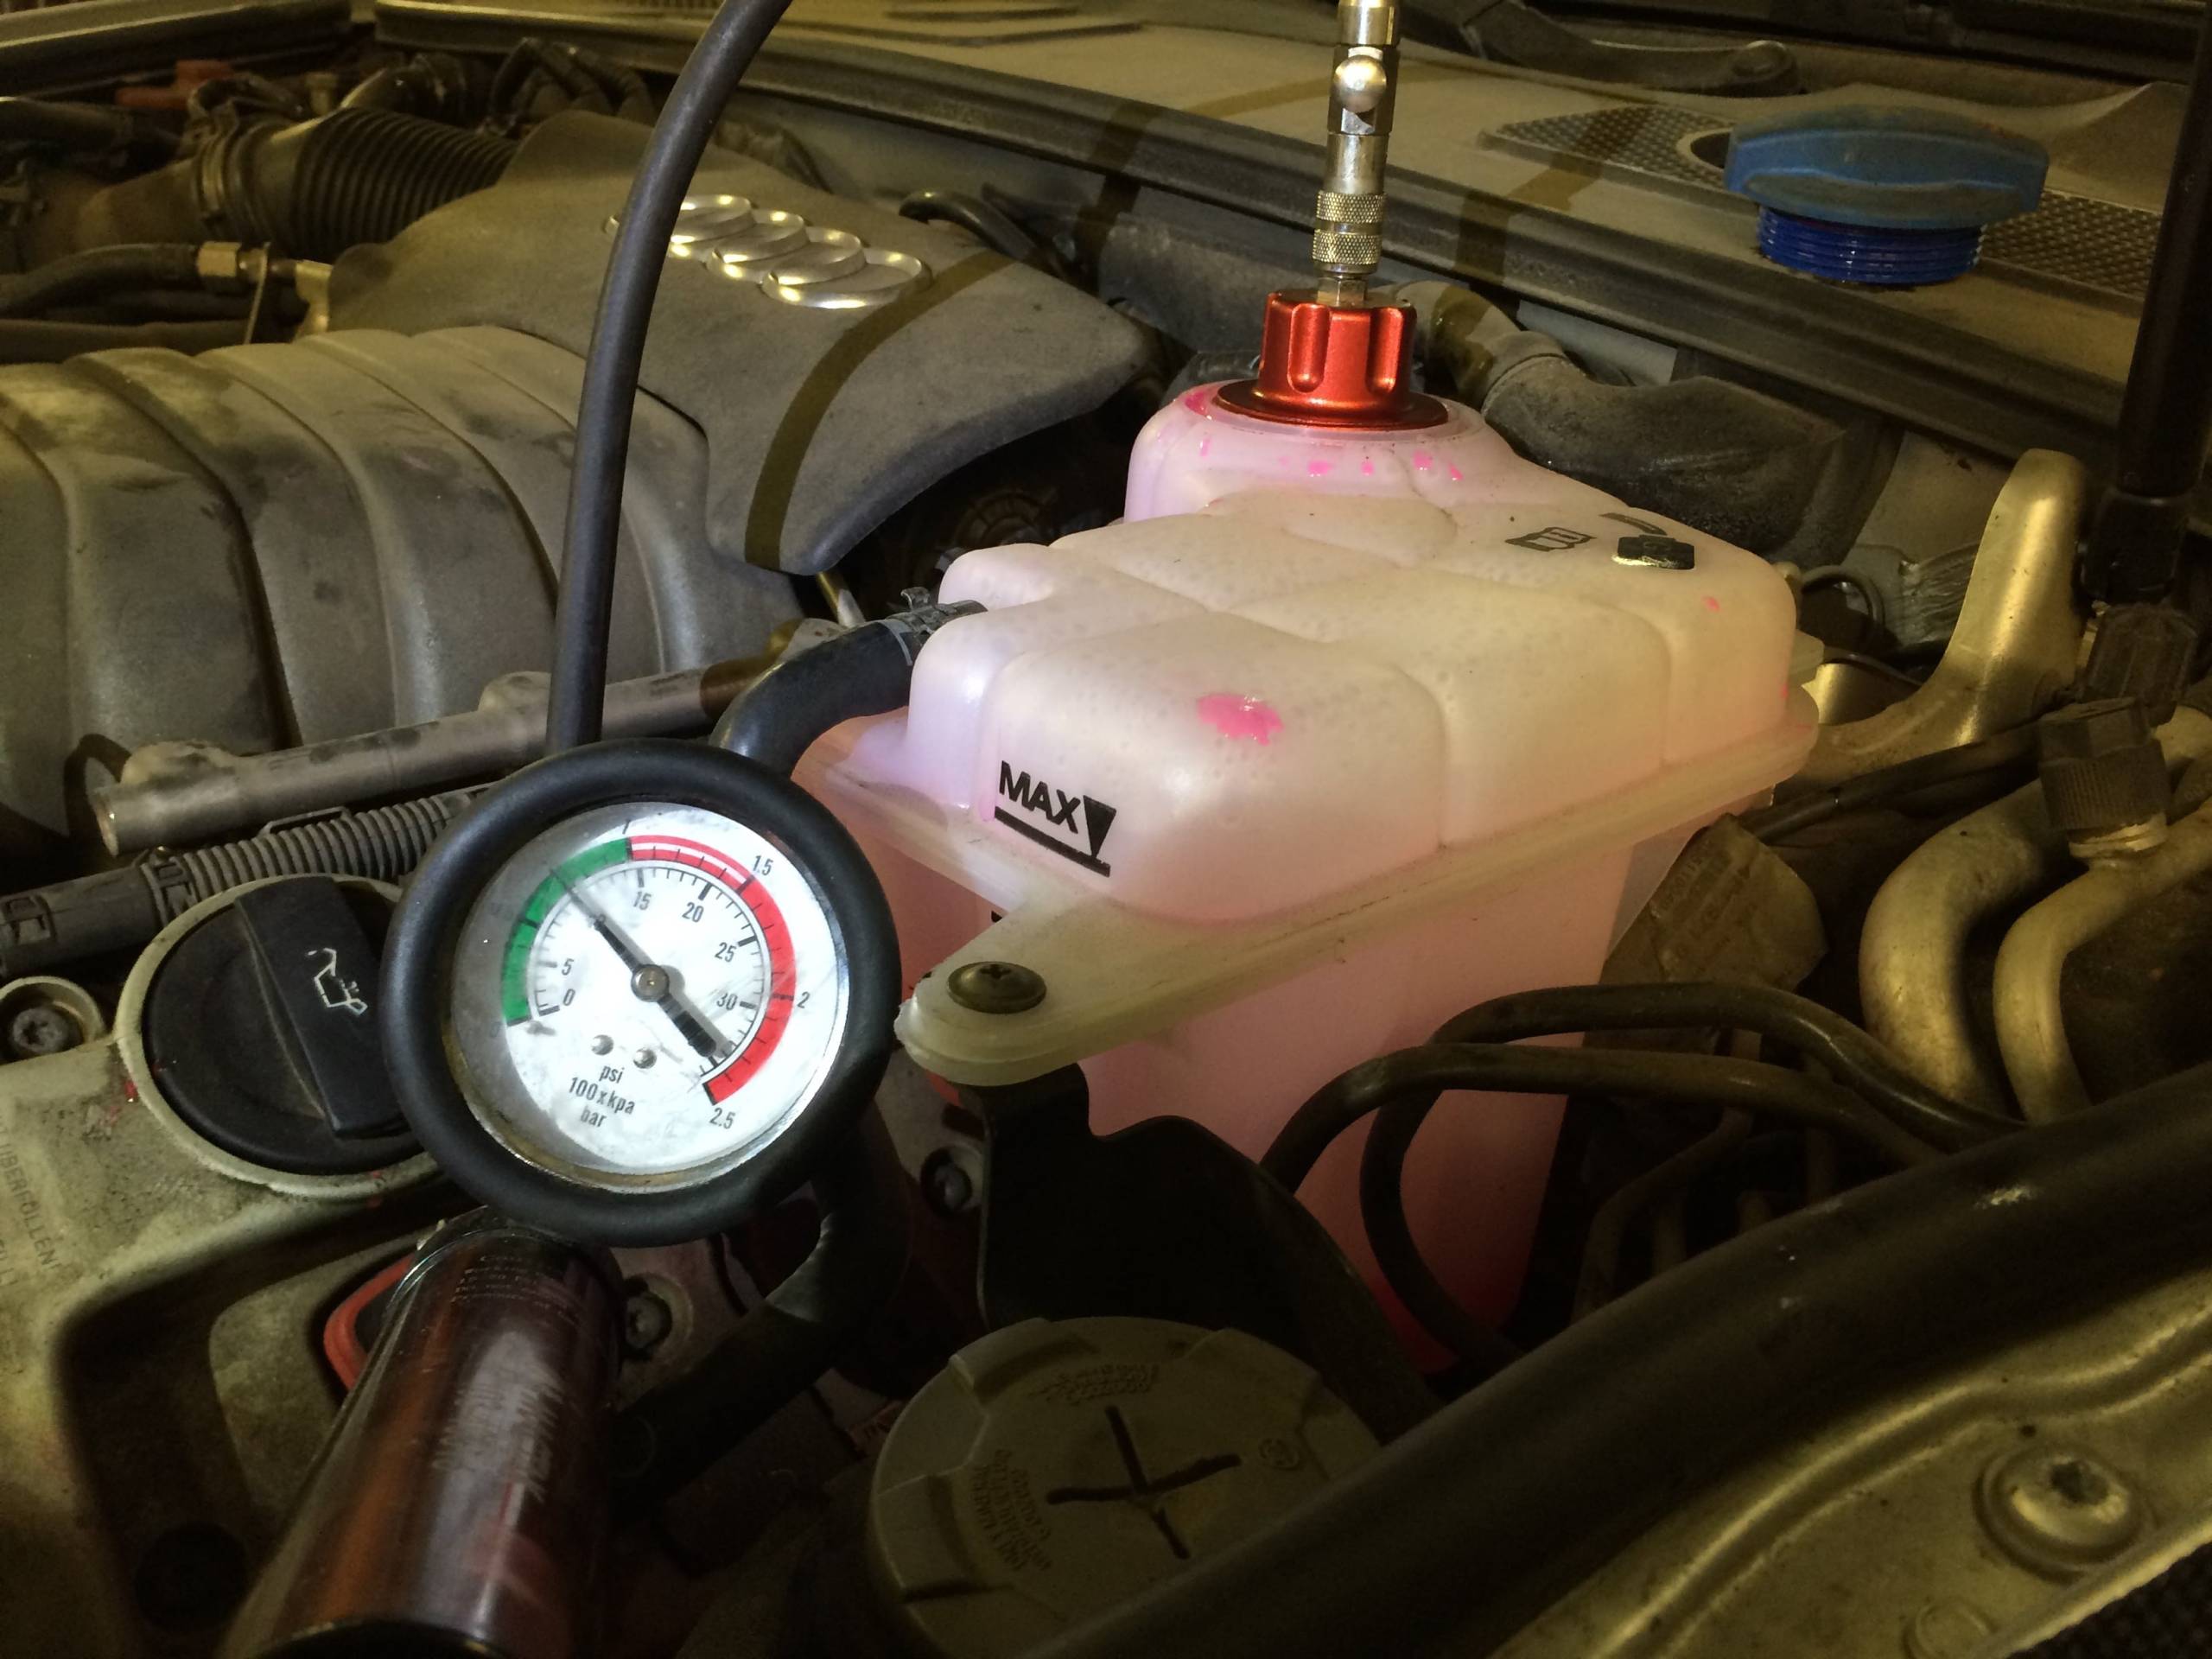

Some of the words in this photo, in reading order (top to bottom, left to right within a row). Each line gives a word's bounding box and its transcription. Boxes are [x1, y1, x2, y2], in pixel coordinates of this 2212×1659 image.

[999, 760, 1081, 835] MAX
[753, 855, 774, 876] 1.5
[632, 890, 652, 912] 15
[681, 901, 704, 923] 20
[714, 941, 737, 963] 25
[561, 957, 575, 976] 5
[562, 988, 576, 1007] 0
[715, 991, 739, 1011] 30
[797, 990, 810, 1009] 2
[598, 1065, 625, 1084] psi
[580, 1105, 607, 1128] bar
[709, 1107, 736, 1130] 2.5
